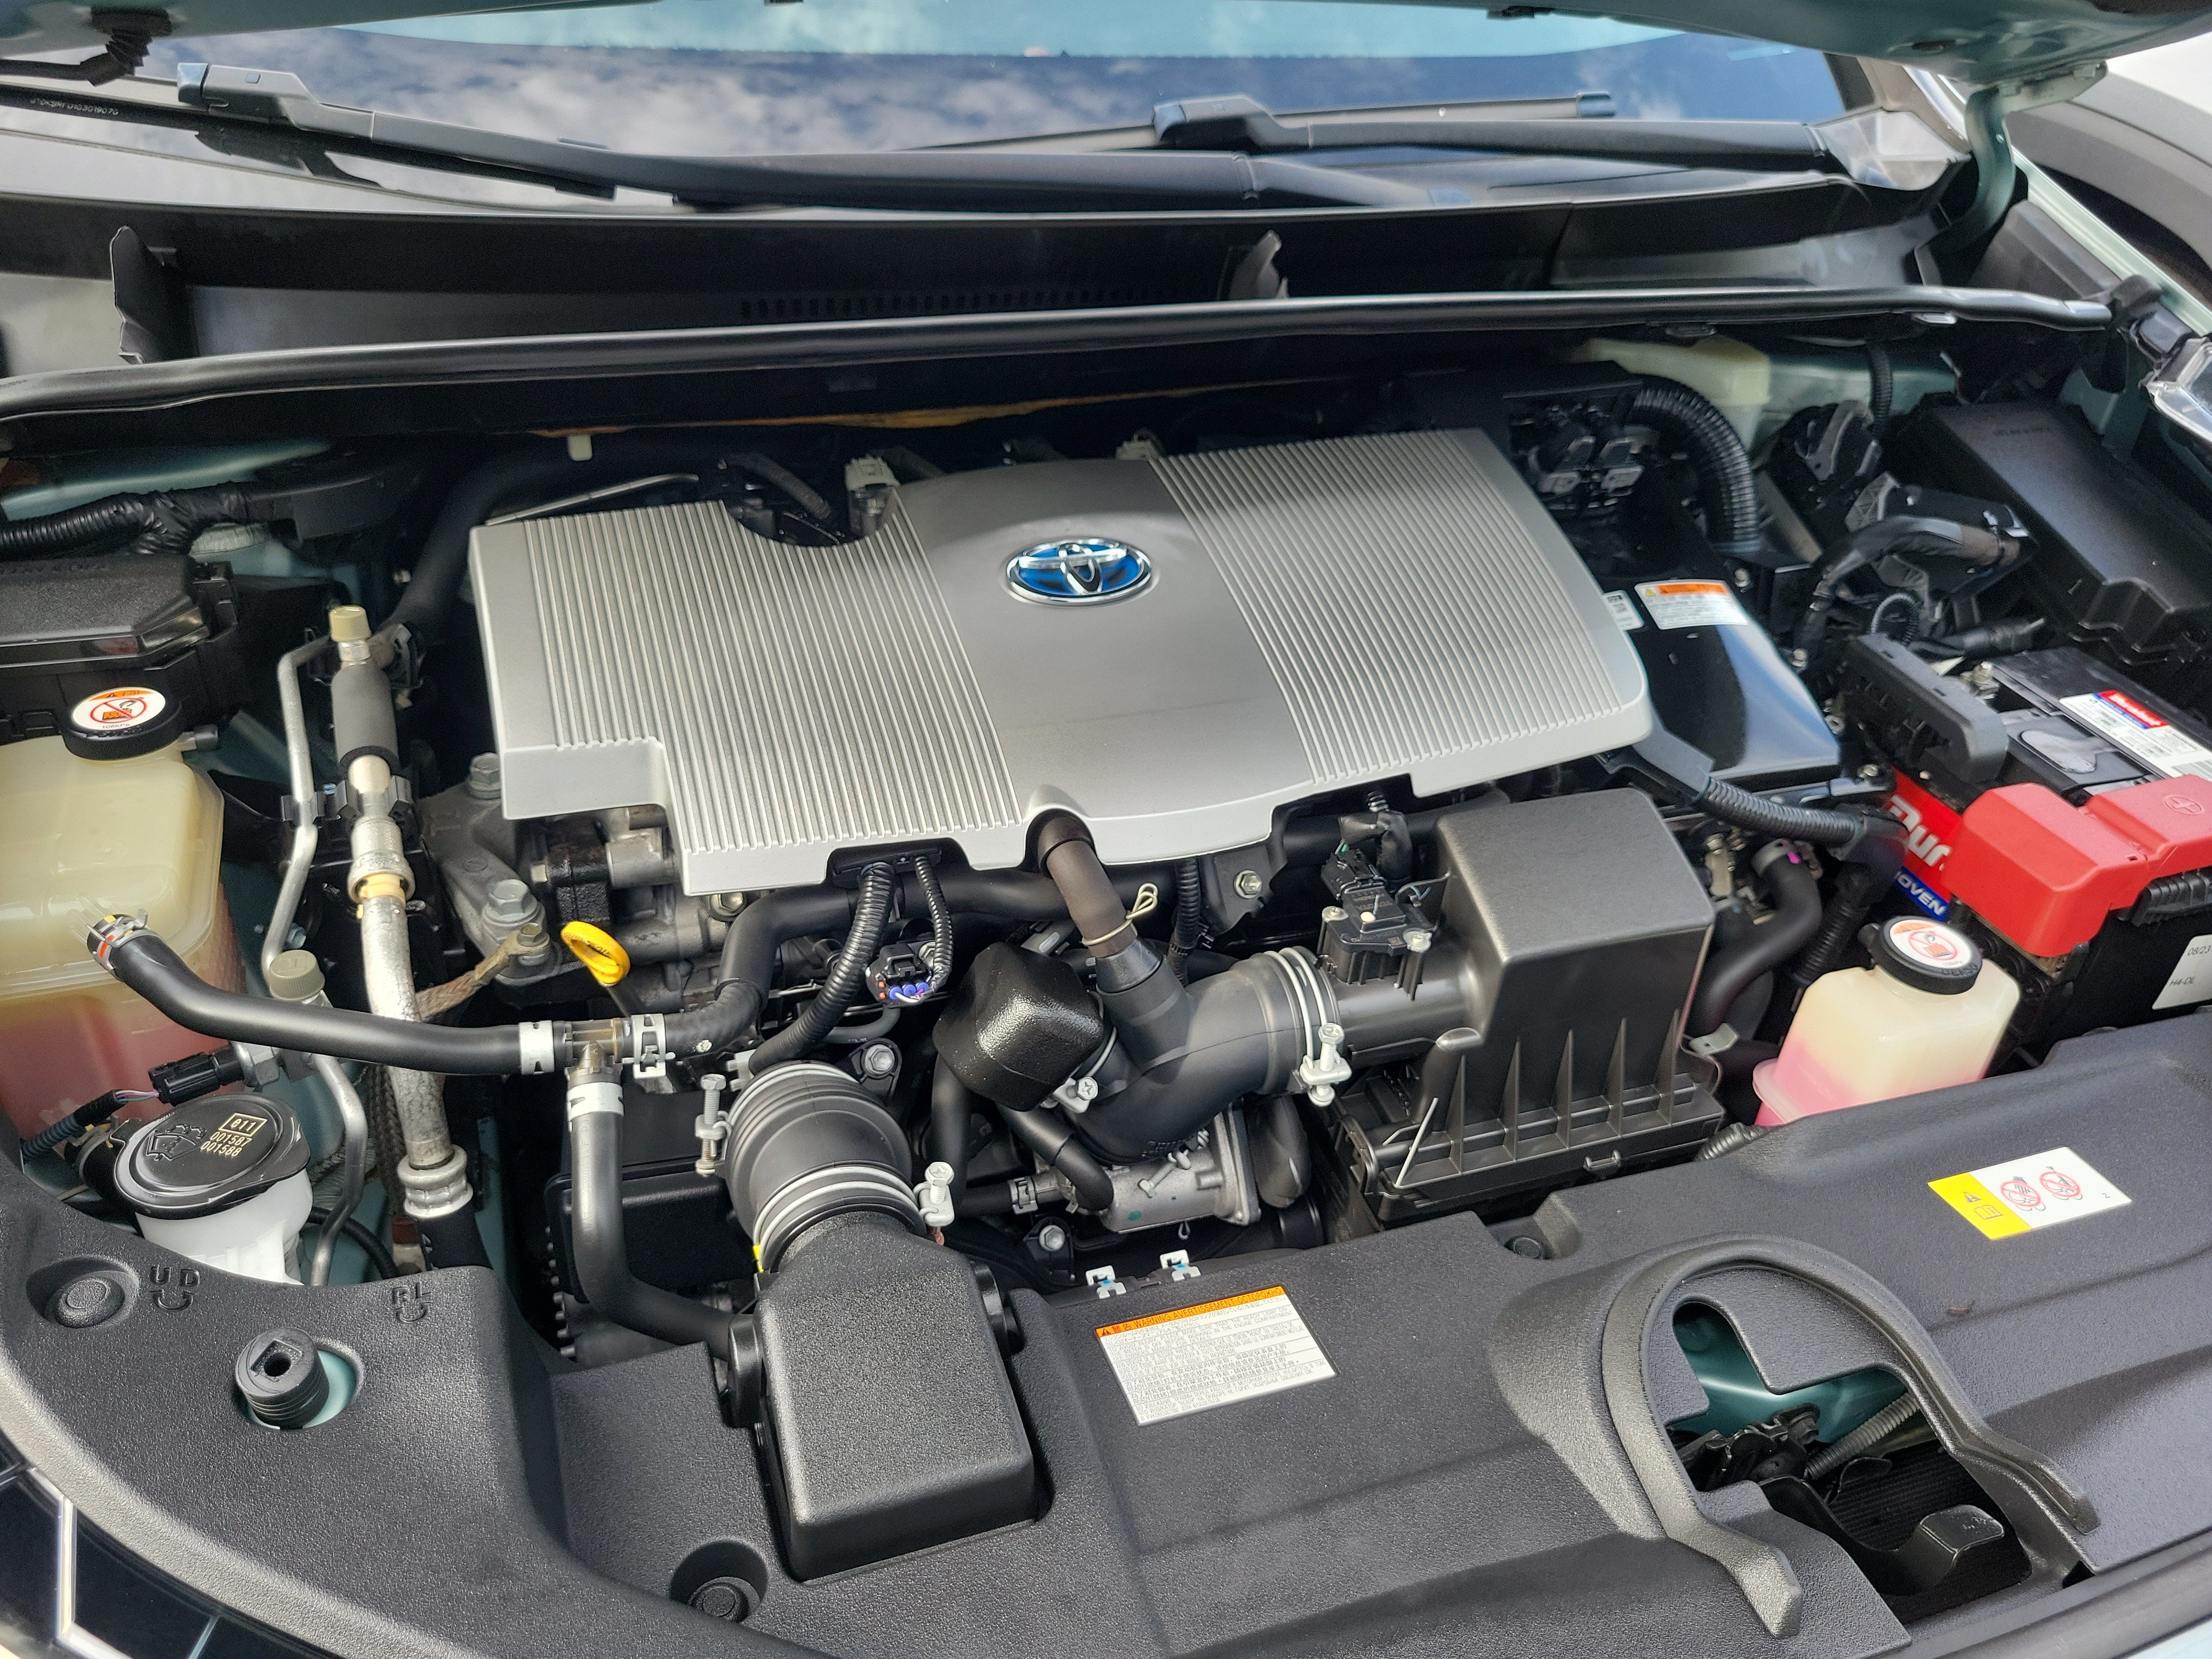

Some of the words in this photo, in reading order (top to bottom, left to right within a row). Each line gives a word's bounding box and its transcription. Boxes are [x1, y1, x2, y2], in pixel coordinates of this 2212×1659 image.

[1894, 871, 1946, 916] OVEN
[230, 1116, 255, 1132] e11
[210, 1131, 253, 1147] 001587
[201, 1140, 242, 1156] 001588
[1133, 1313, 1171, 1328] WARNING
[1172, 1298, 1237, 1318] AVERTISSEMENT
[1235, 1288, 1282, 1304] ОСТОРОЖНО
